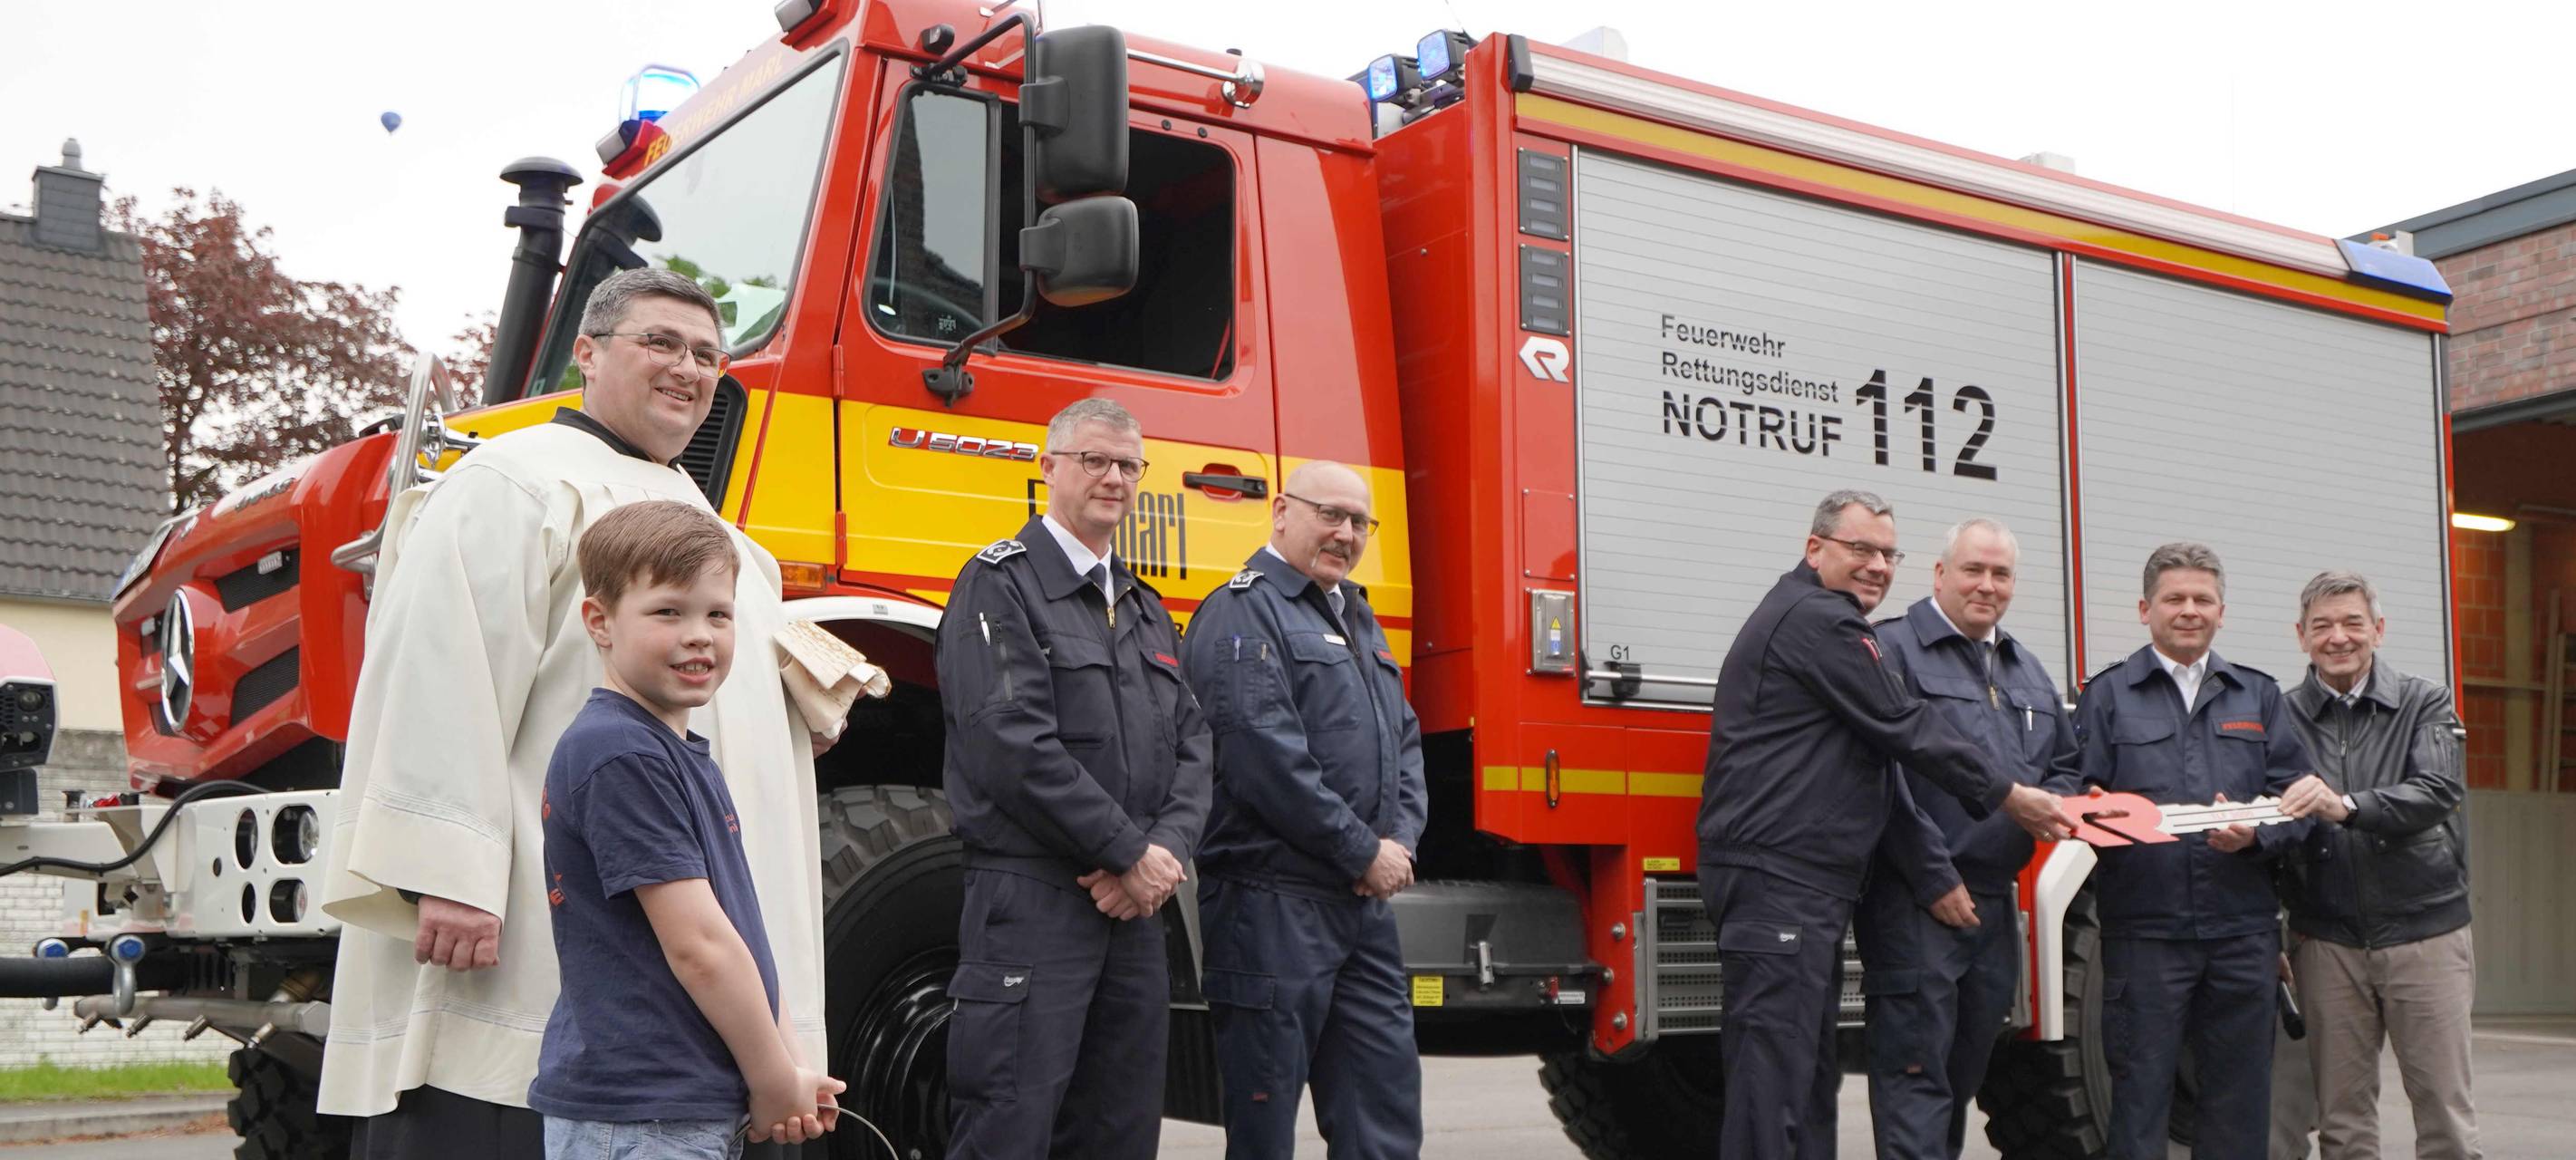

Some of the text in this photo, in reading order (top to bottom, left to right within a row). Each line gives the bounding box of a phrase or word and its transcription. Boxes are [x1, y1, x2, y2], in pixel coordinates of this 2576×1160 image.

[1662, 314, 1787, 359] Feuerwehr
[1662, 351, 1840, 404] Rettungsdienst
[891, 427, 1039, 460] U 5023
[1663, 369, 1998, 481] NOTRUF 112
[1610, 644, 1629, 661] G1
